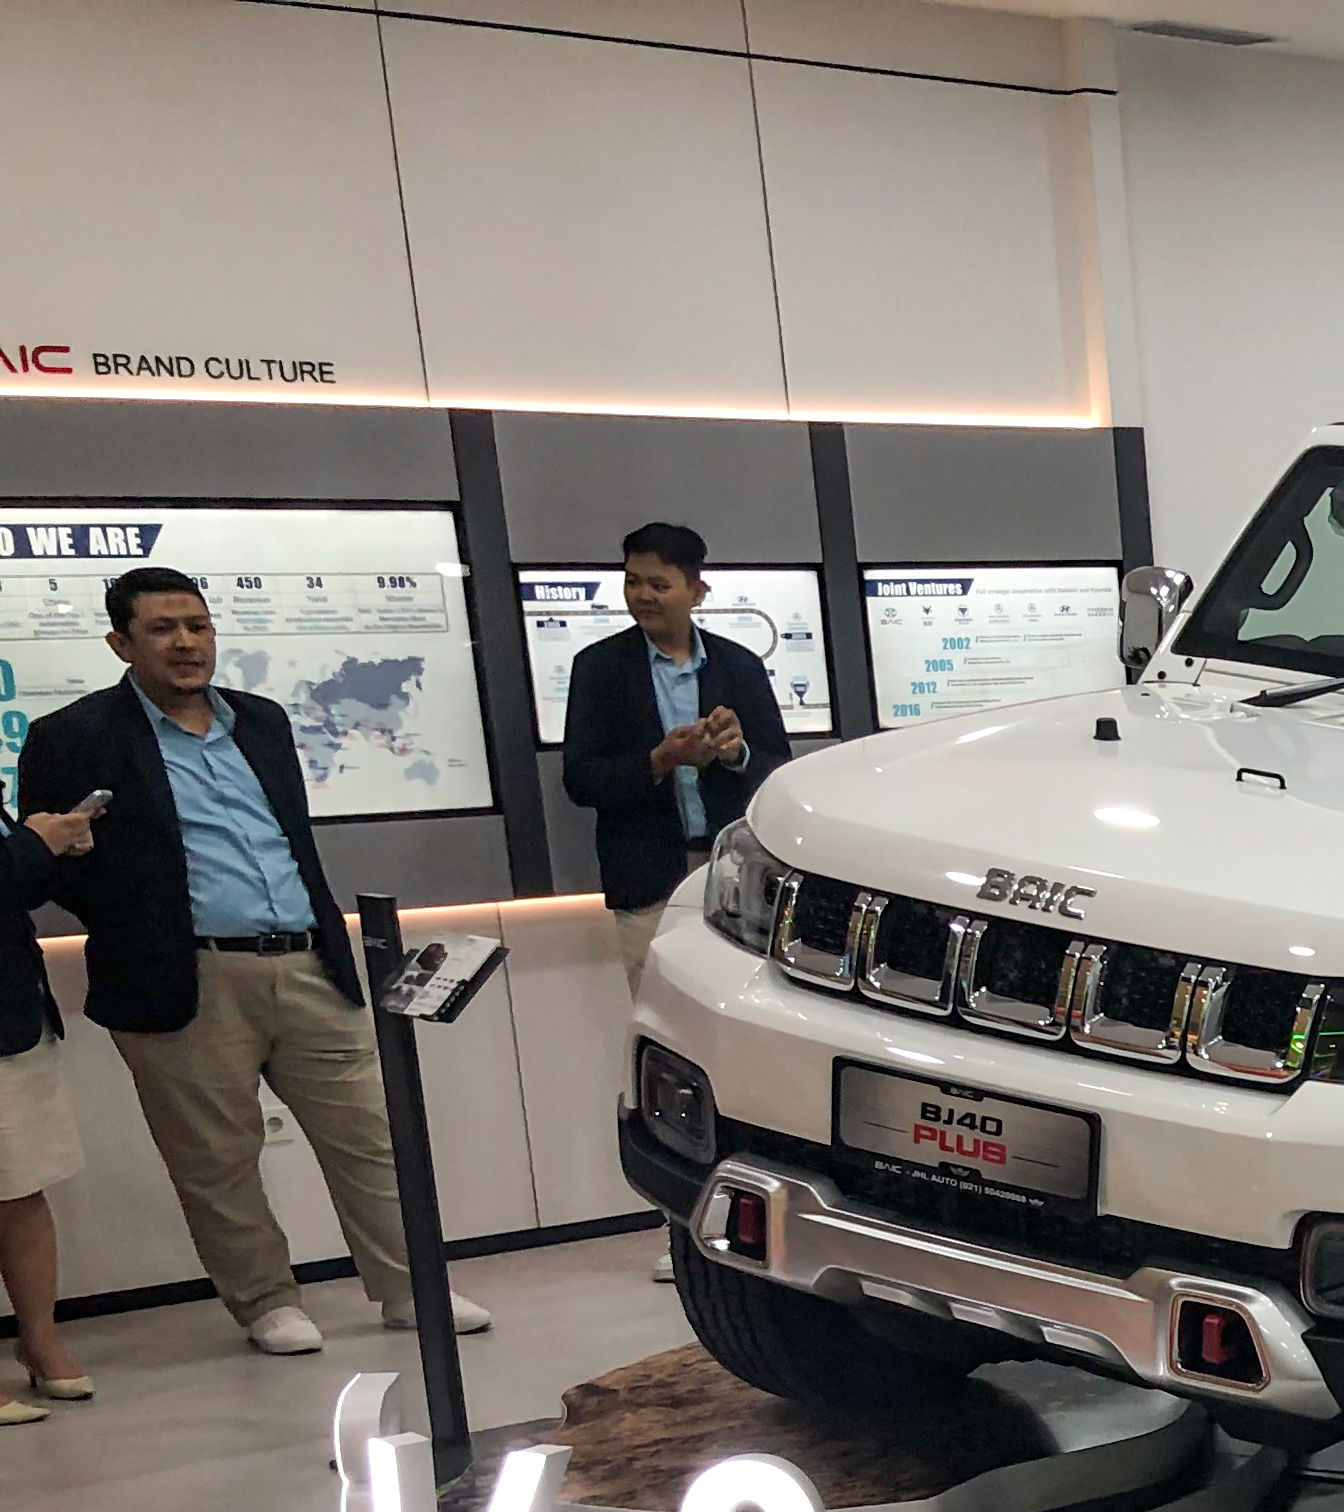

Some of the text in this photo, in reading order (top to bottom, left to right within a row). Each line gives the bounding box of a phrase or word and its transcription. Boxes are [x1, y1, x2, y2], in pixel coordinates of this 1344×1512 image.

[0, 344, 337, 384] IC BRAND CULTURE
[26, 526, 76, 556] WE
[89, 526, 144, 556] ARE
[48, 578, 58, 592] 5
[236, 576, 263, 590] 450
[306, 576, 324, 589] 34
[877, 581, 963, 596] Joint Ventures
[534, 584, 586, 601] History
[941, 637, 971, 651] 2002
[924, 658, 954, 673] 2005
[911, 681, 938, 695] 2012
[893, 703, 921, 717] 2016
[976, 867, 1098, 921] BAIC
[920, 1102, 1003, 1137] BJ40
[913, 1123, 1007, 1166] PLUS
[874, 1160, 902, 1174] BAIC
[931, 1174, 958, 1187] AUTO
